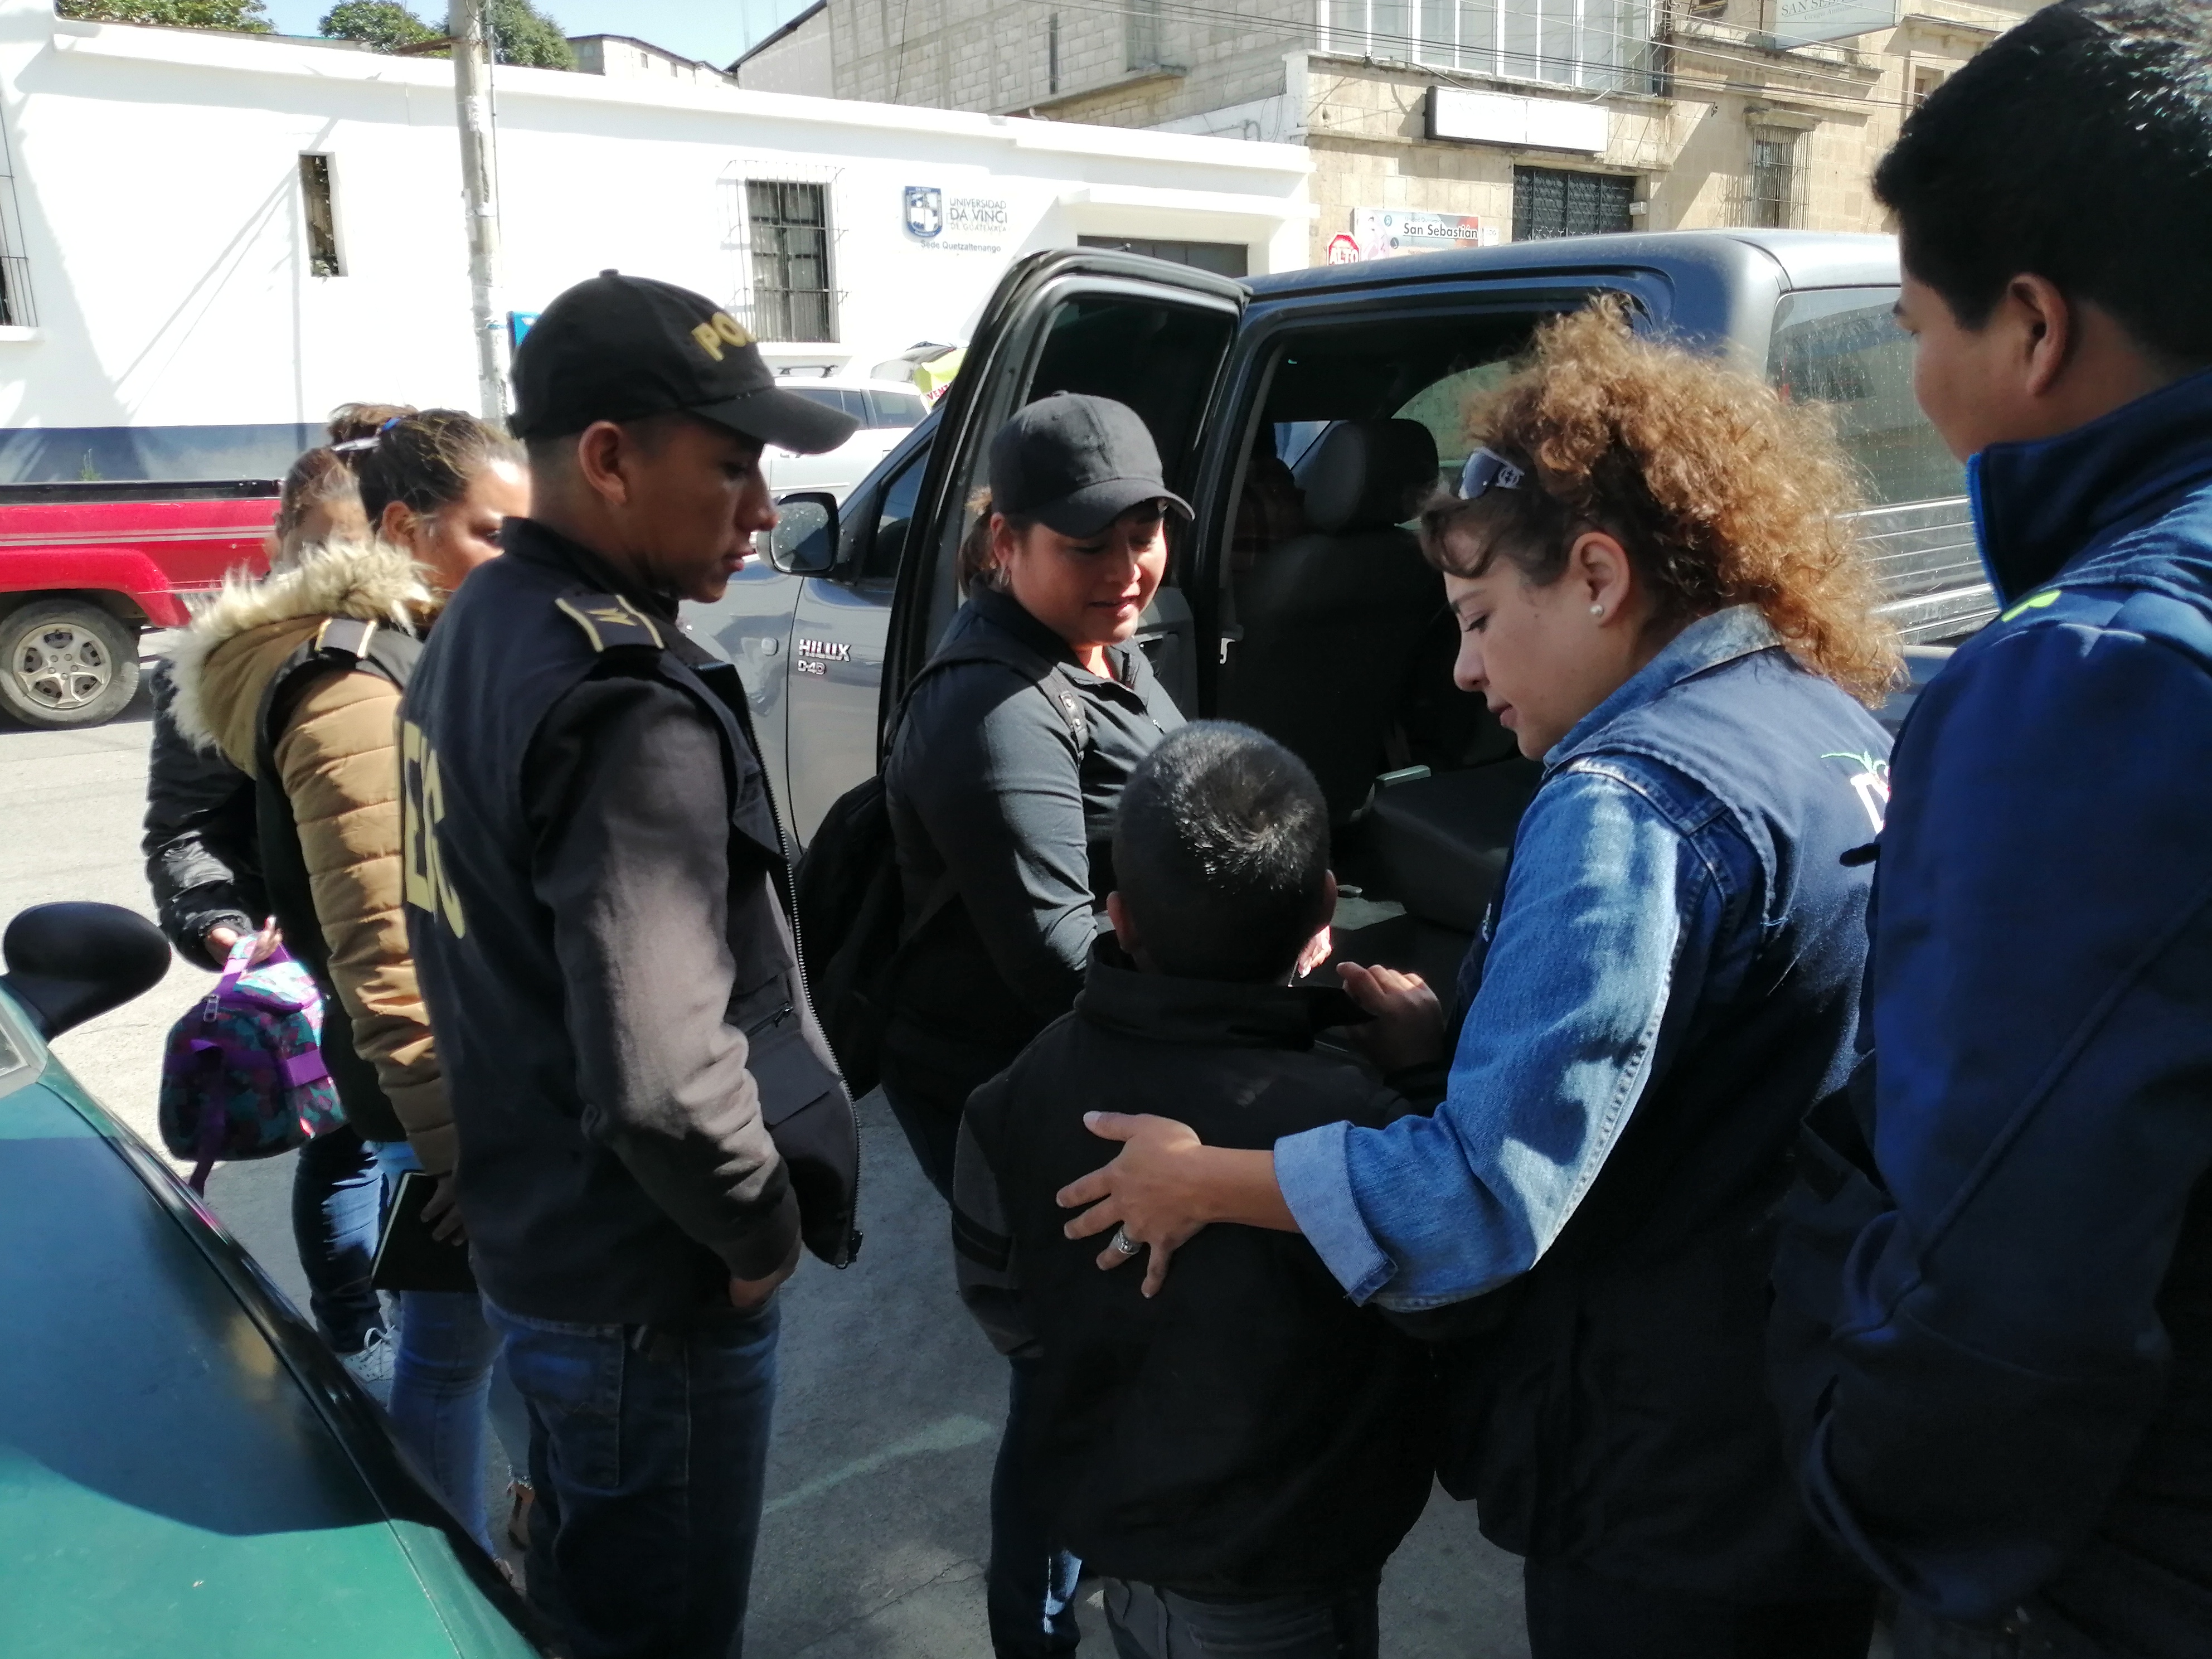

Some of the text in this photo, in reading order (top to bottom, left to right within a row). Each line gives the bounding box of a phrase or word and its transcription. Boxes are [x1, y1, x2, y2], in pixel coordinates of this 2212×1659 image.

[1782, 0, 1807, 16] SAN
[949, 197, 1007, 209] UNIVERSIDAD
[950, 207, 1007, 224] DA VINCI
[950, 222, 1007, 232] DE GUATEMALA
[1404, 222, 1478, 239] San Sebastián
[920, 240, 1001, 254] Sede Quetzaltenango
[1329, 247, 1358, 265] ALTO
[691, 311, 756, 362] PO
[798, 638, 851, 662] HILUX
